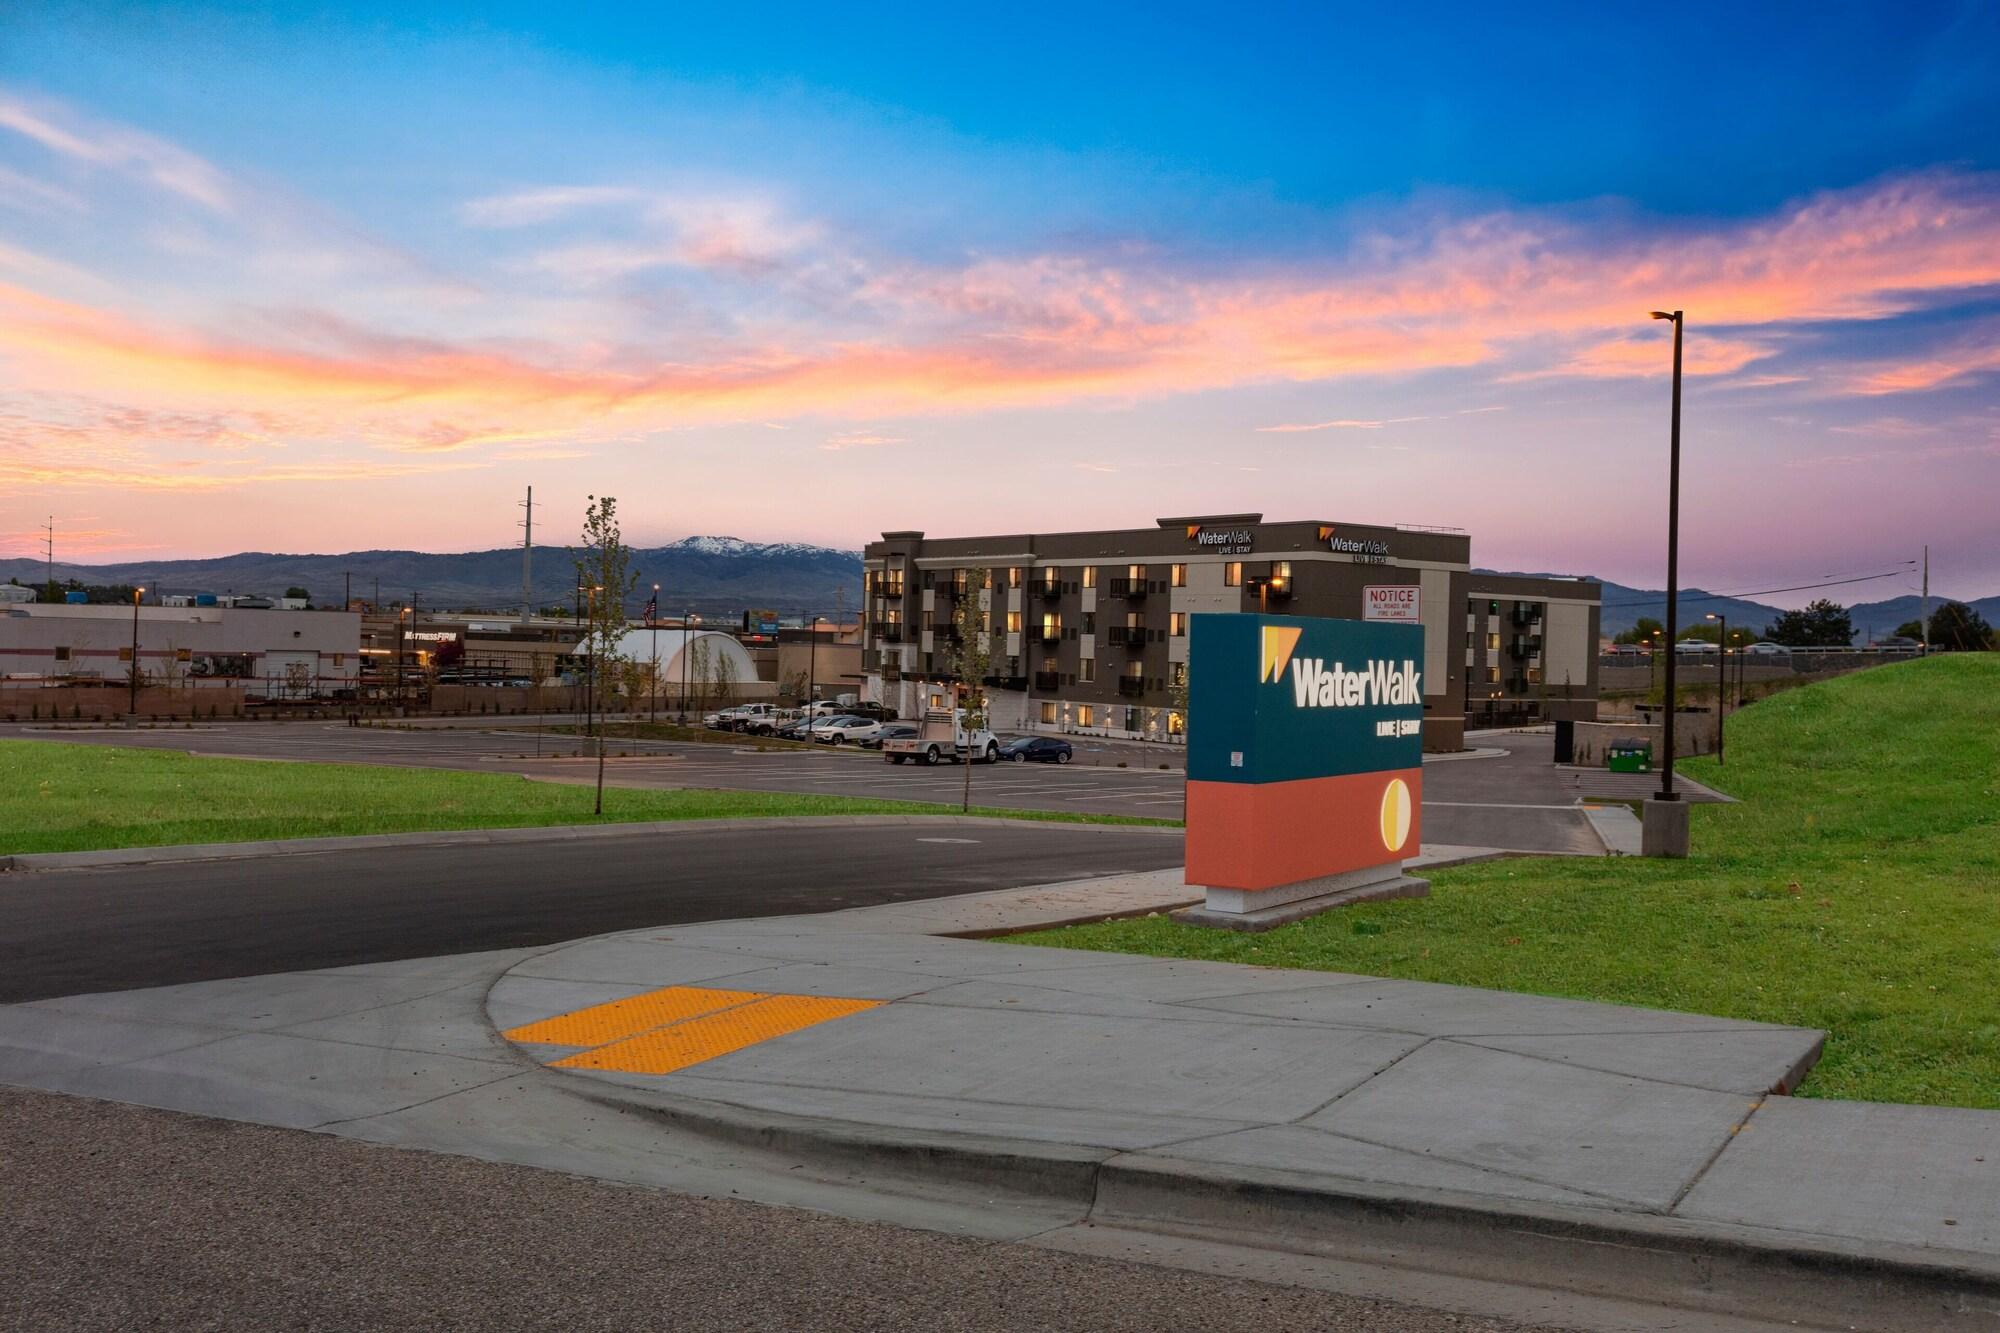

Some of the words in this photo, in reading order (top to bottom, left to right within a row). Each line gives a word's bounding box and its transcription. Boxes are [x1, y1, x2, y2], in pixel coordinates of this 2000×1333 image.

[1198, 530, 1252, 545] WaterWalk
[1219, 546, 1232, 554] LIVE
[1236, 545, 1251, 553] STAY
[1330, 537, 1389, 554] WaterWalk
[1370, 590, 1415, 602] NOTICE
[1292, 658, 1421, 707] WaterWalk
